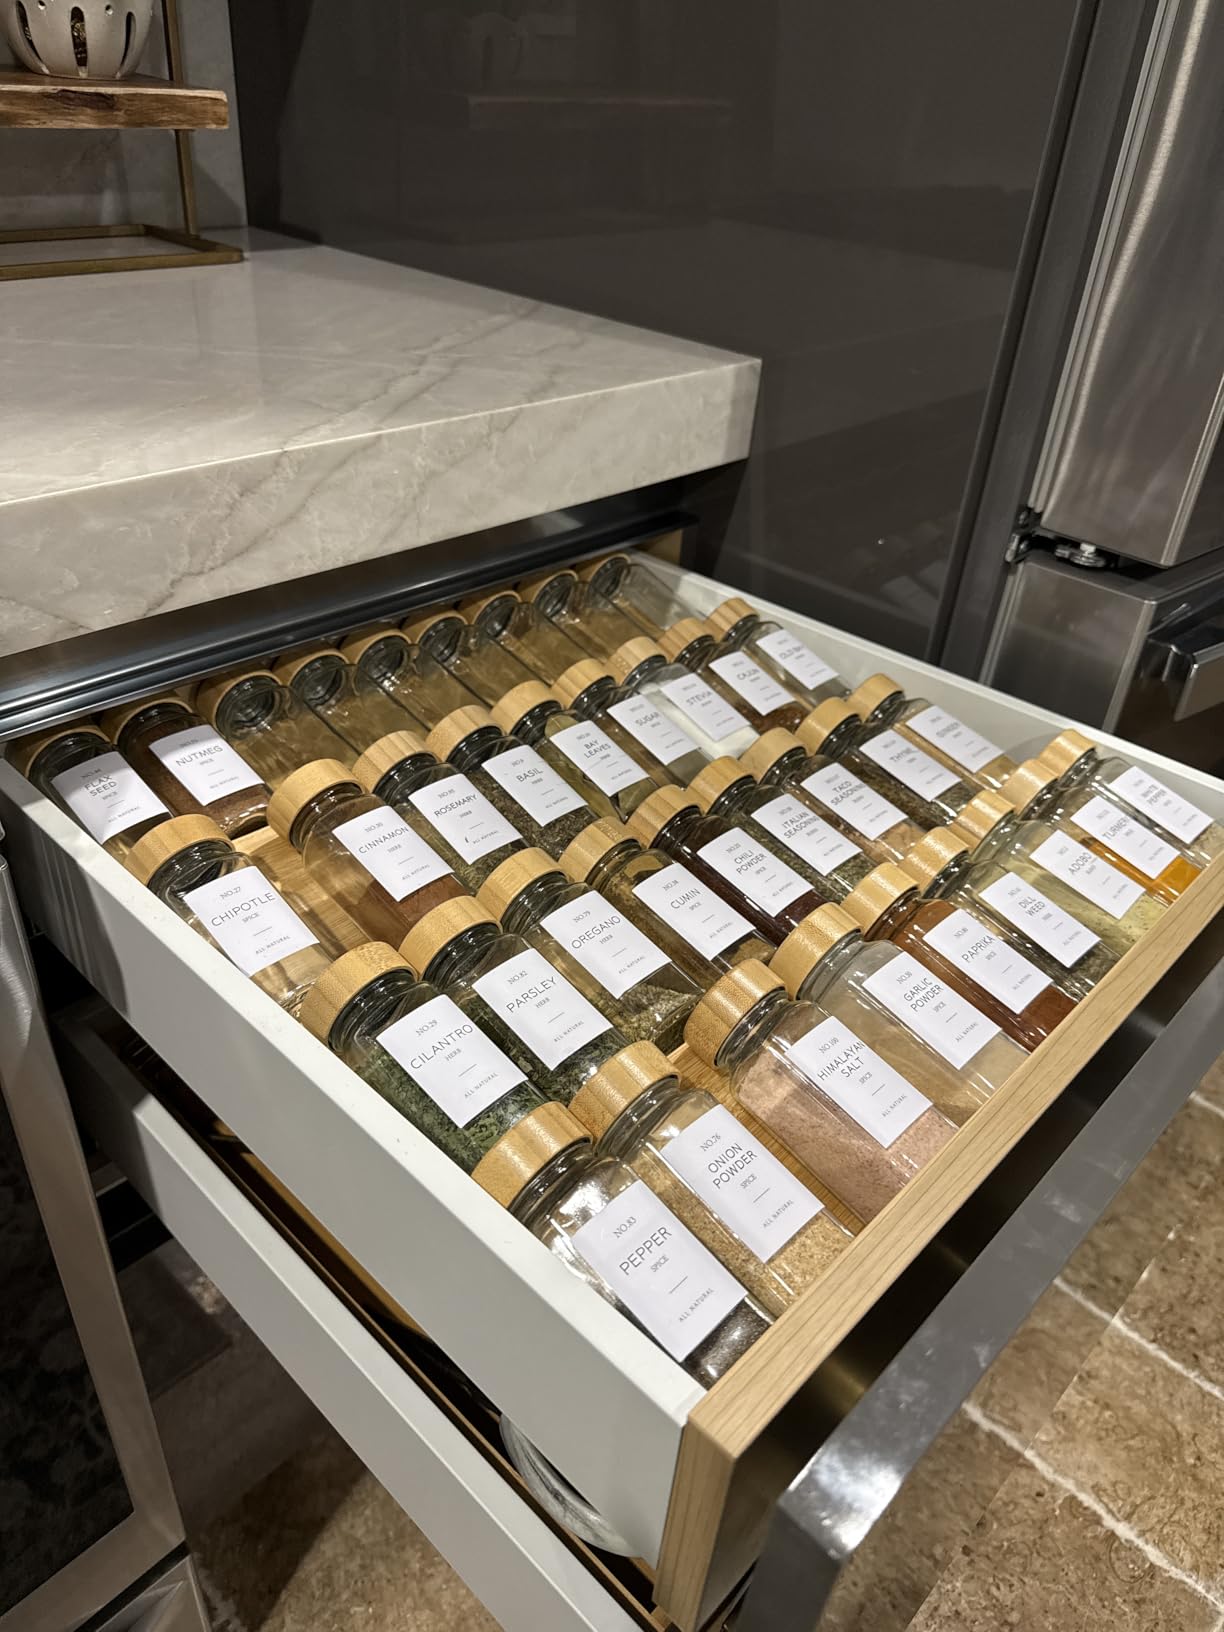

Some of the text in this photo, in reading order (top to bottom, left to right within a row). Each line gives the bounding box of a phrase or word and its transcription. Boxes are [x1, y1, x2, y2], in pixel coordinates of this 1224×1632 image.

[634, 712, 661, 726] SUGAR
[583, 743, 611, 759] LEAVES
[584, 740, 599, 750] BAY
[175, 745, 223, 767] NUTMEG
[84, 775, 113, 791] FLAX
[218, 776, 239, 785] NATURAL
[516, 768, 543, 782] BASIL
[89, 781, 117, 797] SEED
[830, 783, 865, 806] SEASON
[832, 781, 852, 793] TACO
[117, 806, 140, 818] NATURAL
[433, 794, 477, 817] ROSEMARY
[781, 812, 810, 829] ITALIAN
[1101, 816, 1130, 840] TURMER
[358, 826, 409, 854] CINNAMON
[734, 850, 754, 865] CHILI
[736, 853, 767, 875] POWDER
[1068, 852, 1092, 875] ADOBO
[410, 864, 430, 875] NATURAL
[219, 886, 241, 900] NO.27
[670, 888, 701, 909] CUMIN
[1018, 896, 1037, 909] DILL
[211, 892, 276, 927] CHIPOTLE
[241, 912, 260, 923] SPICE
[572, 910, 591, 923] NO.79
[1025, 901, 1046, 916] WEED
[571, 915, 621, 949] OREGANO
[599, 934, 613, 944] HERB
[255, 935, 291, 955] ALL NATURAL
[961, 935, 996, 963] PAPRIKA
[618, 956, 645, 974] ALL NATURAL
[507, 970, 528, 985] NO.82
[506, 976, 556, 1013] PARSLEY
[903, 977, 933, 1002] GARLIC
[910, 984, 944, 1012] POWDER
[535, 997, 550, 1008] HERB
[932, 1001, 946, 1013] SPICE
[415, 1019, 438, 1036] NO.29
[563, 1020, 584, 1035] NATURAL
[955, 1022, 979, 1043] ALL NATURAL
[410, 1024, 473, 1069] CILANTRO
[444, 1048, 462, 1061] HERB
[817, 1041, 866, 1081] HIMALAYAN
[840, 1056, 864, 1078] SALT
[464, 1072, 499, 1099] ALL NATURAL
[858, 1071, 873, 1085] SPICE
[881, 1094, 907, 1117] ALL NATURAL
[699, 1133, 721, 1152] NO.76
[708, 1143, 743, 1173] ONION
[712, 1150, 758, 1189] POWDER
[740, 1173, 757, 1189] SPICE
[763, 1200, 794, 1228] ALL NATURAL
[612, 1216, 637, 1239] NO.83
[619, 1227, 672, 1276] PEPPER
[650, 1254, 670, 1273] SPICE
[678, 1288, 714, 1323] ALL NATURAL
